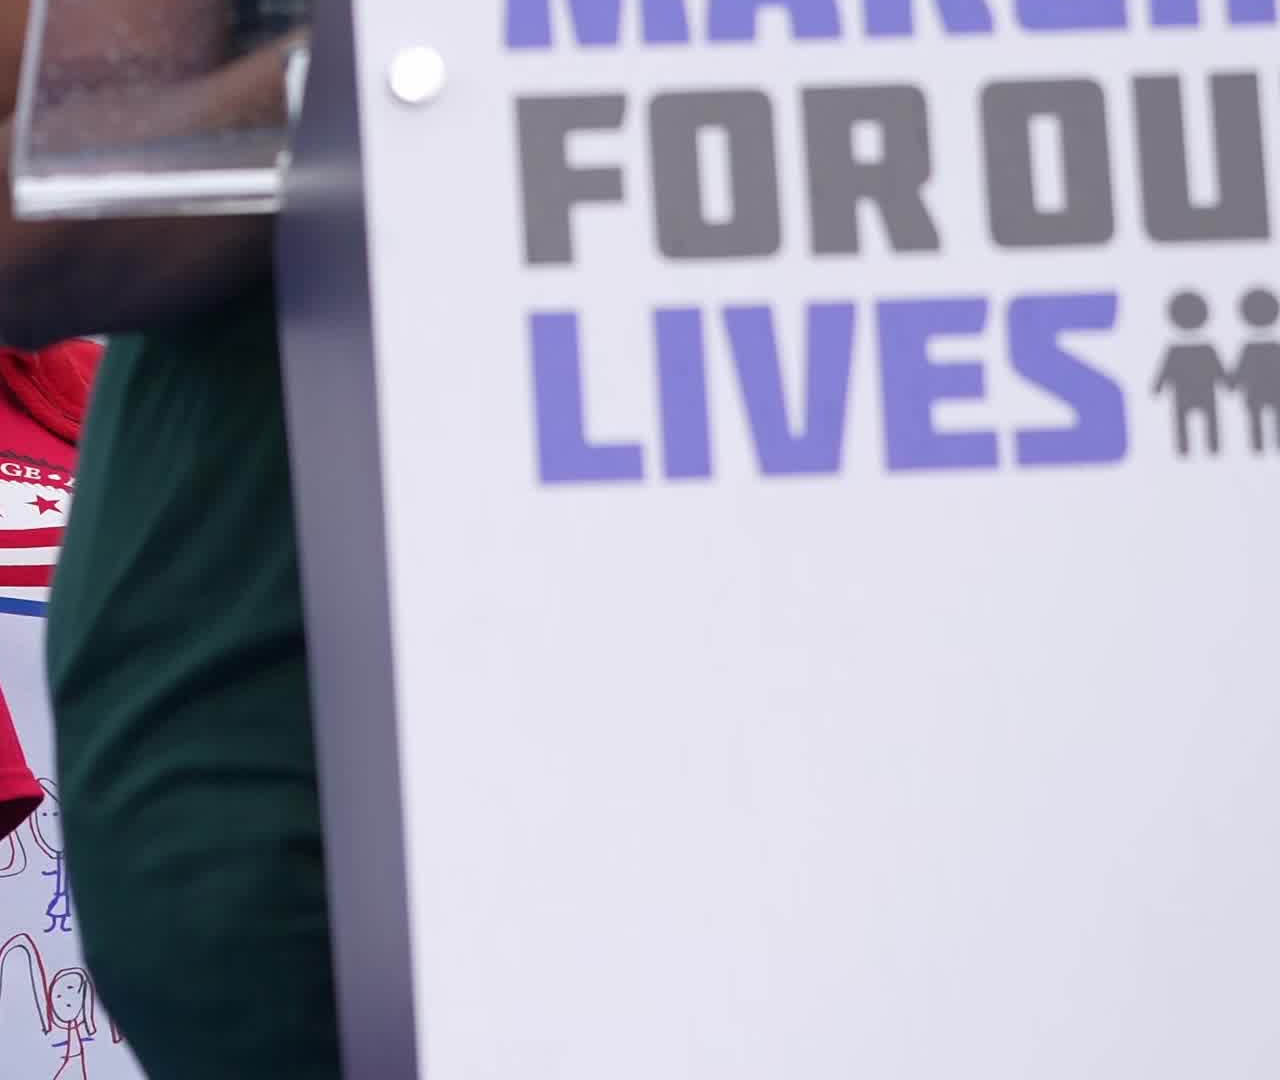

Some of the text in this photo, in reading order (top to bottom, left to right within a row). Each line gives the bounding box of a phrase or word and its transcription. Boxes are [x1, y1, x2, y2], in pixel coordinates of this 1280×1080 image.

[513, 71, 1280, 267] FOR OU
[526, 290, 1130, 486] LIVES
